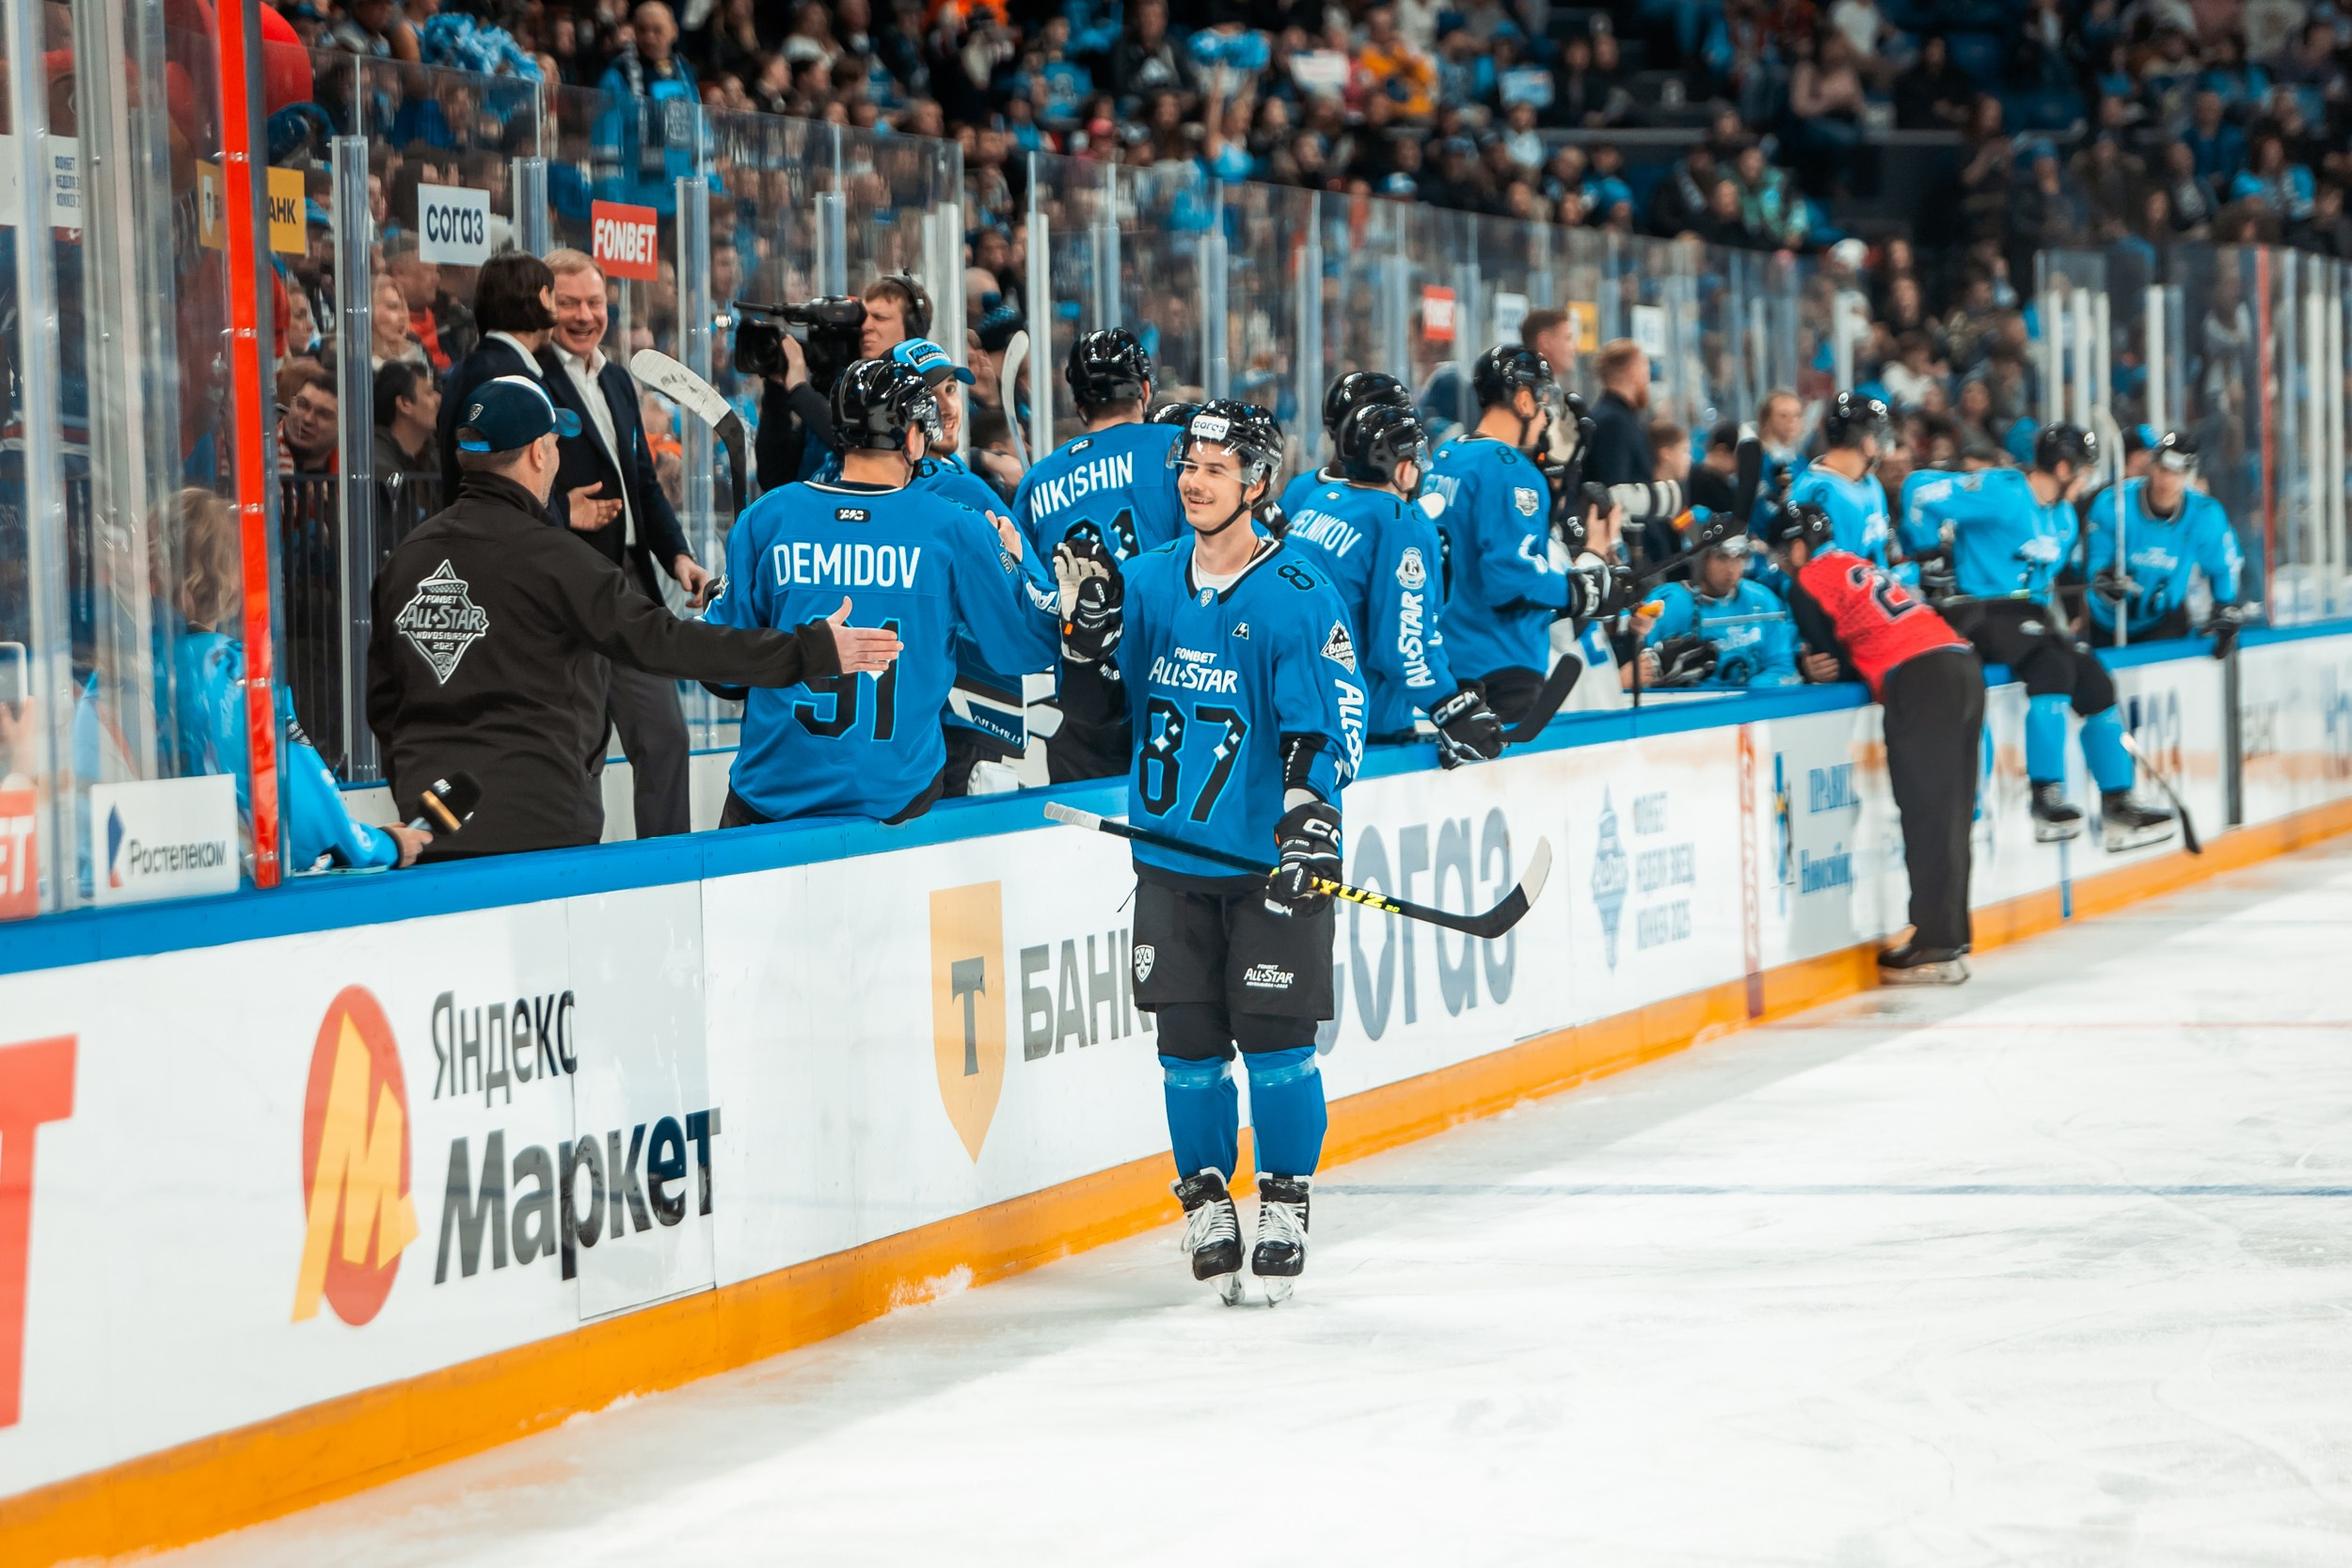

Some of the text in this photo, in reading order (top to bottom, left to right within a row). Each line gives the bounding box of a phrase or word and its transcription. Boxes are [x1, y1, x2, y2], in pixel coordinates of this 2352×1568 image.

[594, 217, 658, 266] FONBET
[1030, 451, 1134, 524] NIKISHIN
[772, 542, 921, 589] DEMIDOV
[424, 594, 457, 605] FONBET
[1094, 582, 1106, 603] CCM
[433, 641, 454, 651] 2025
[1174, 647, 1217, 664] FONBET
[1432, 690, 1480, 728] CCM
[1136, 693, 1251, 826] 87
[0, 815, 36, 896] T
[129, 838, 228, 877] Ростелеком
[432, 990, 579, 1108] Яндекс
[434, 1106, 722, 1286] Маркет
